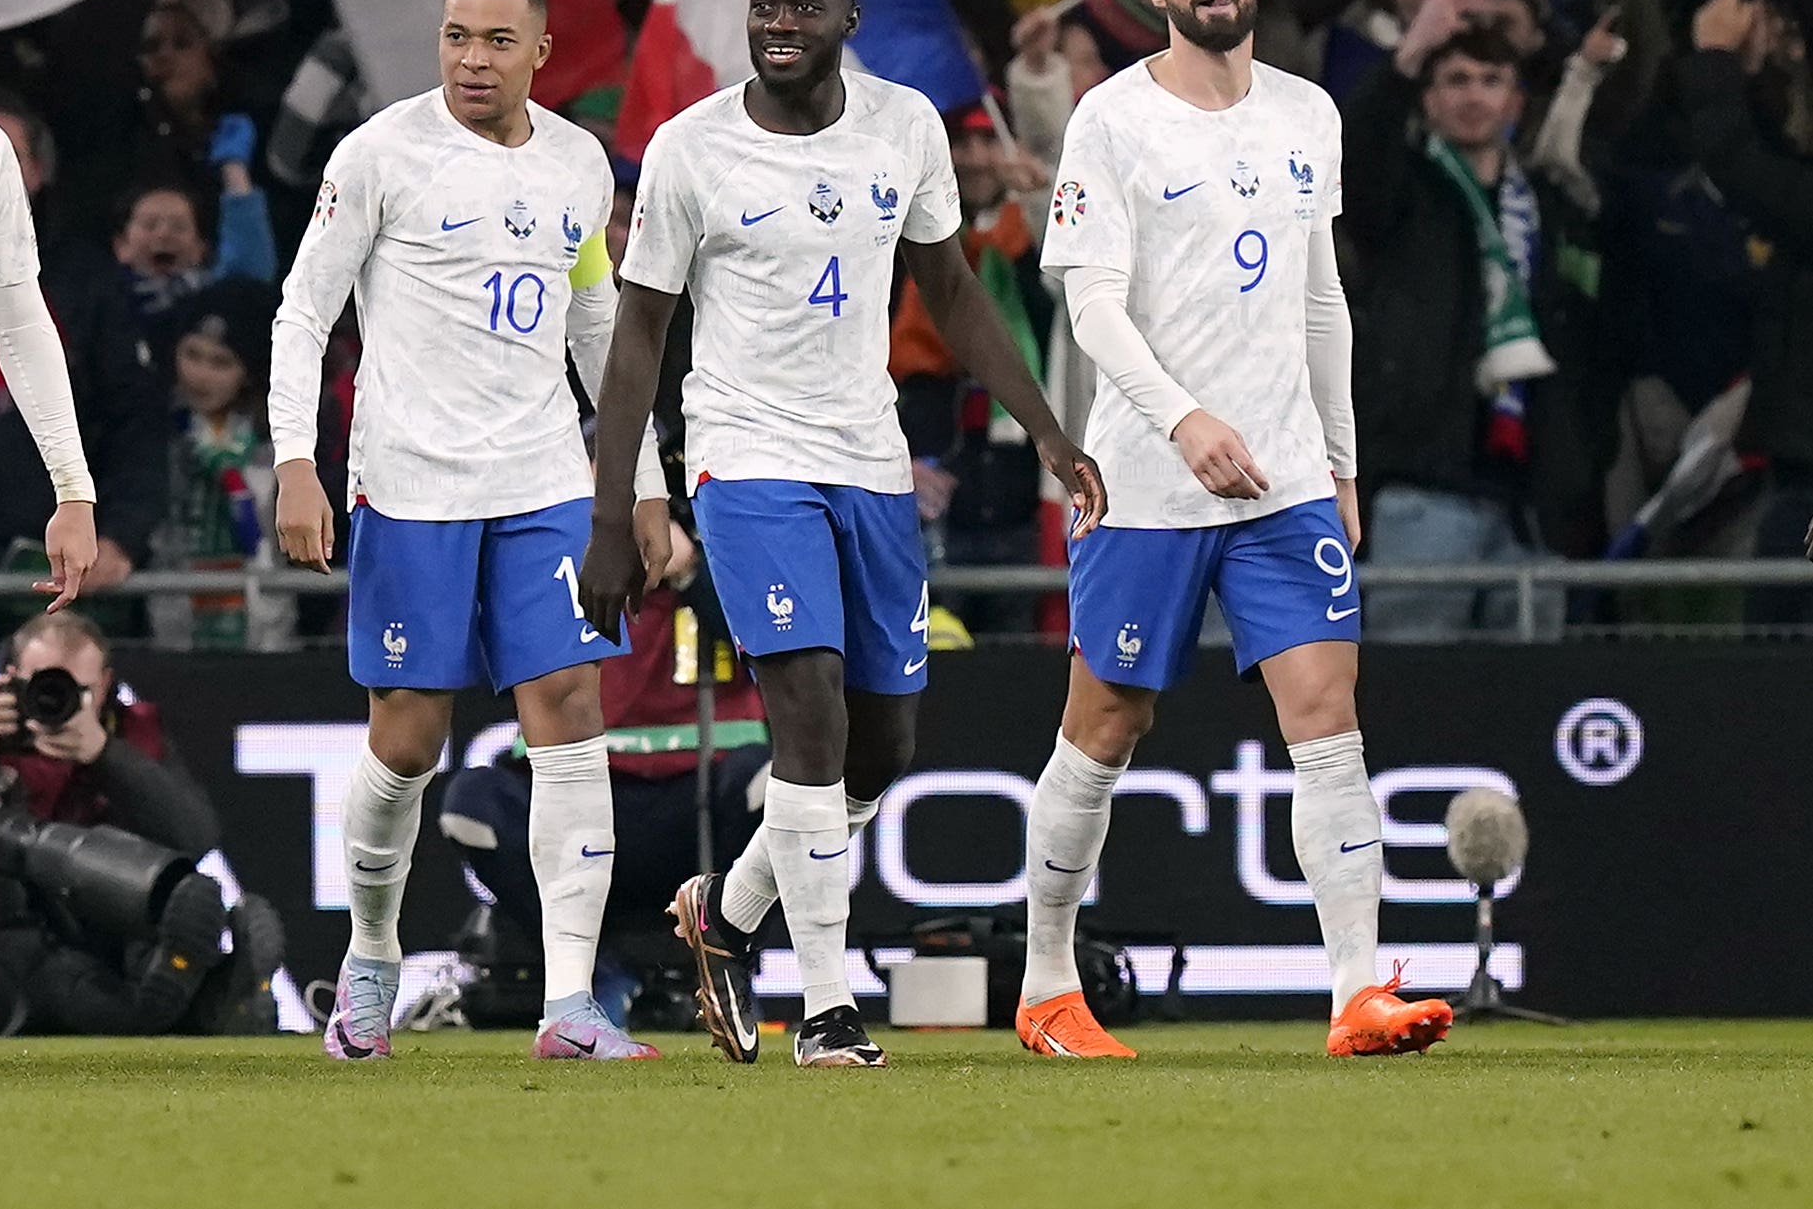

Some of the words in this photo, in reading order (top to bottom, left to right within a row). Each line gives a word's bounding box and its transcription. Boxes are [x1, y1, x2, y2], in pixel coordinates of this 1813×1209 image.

[807, 255, 849, 318] 4
[1233, 229, 1269, 294] 9
[482, 271, 546, 335] 10
[553, 555, 585, 620] 1
[1314, 537, 1352, 598] 9
[909, 579, 931, 645] 4
